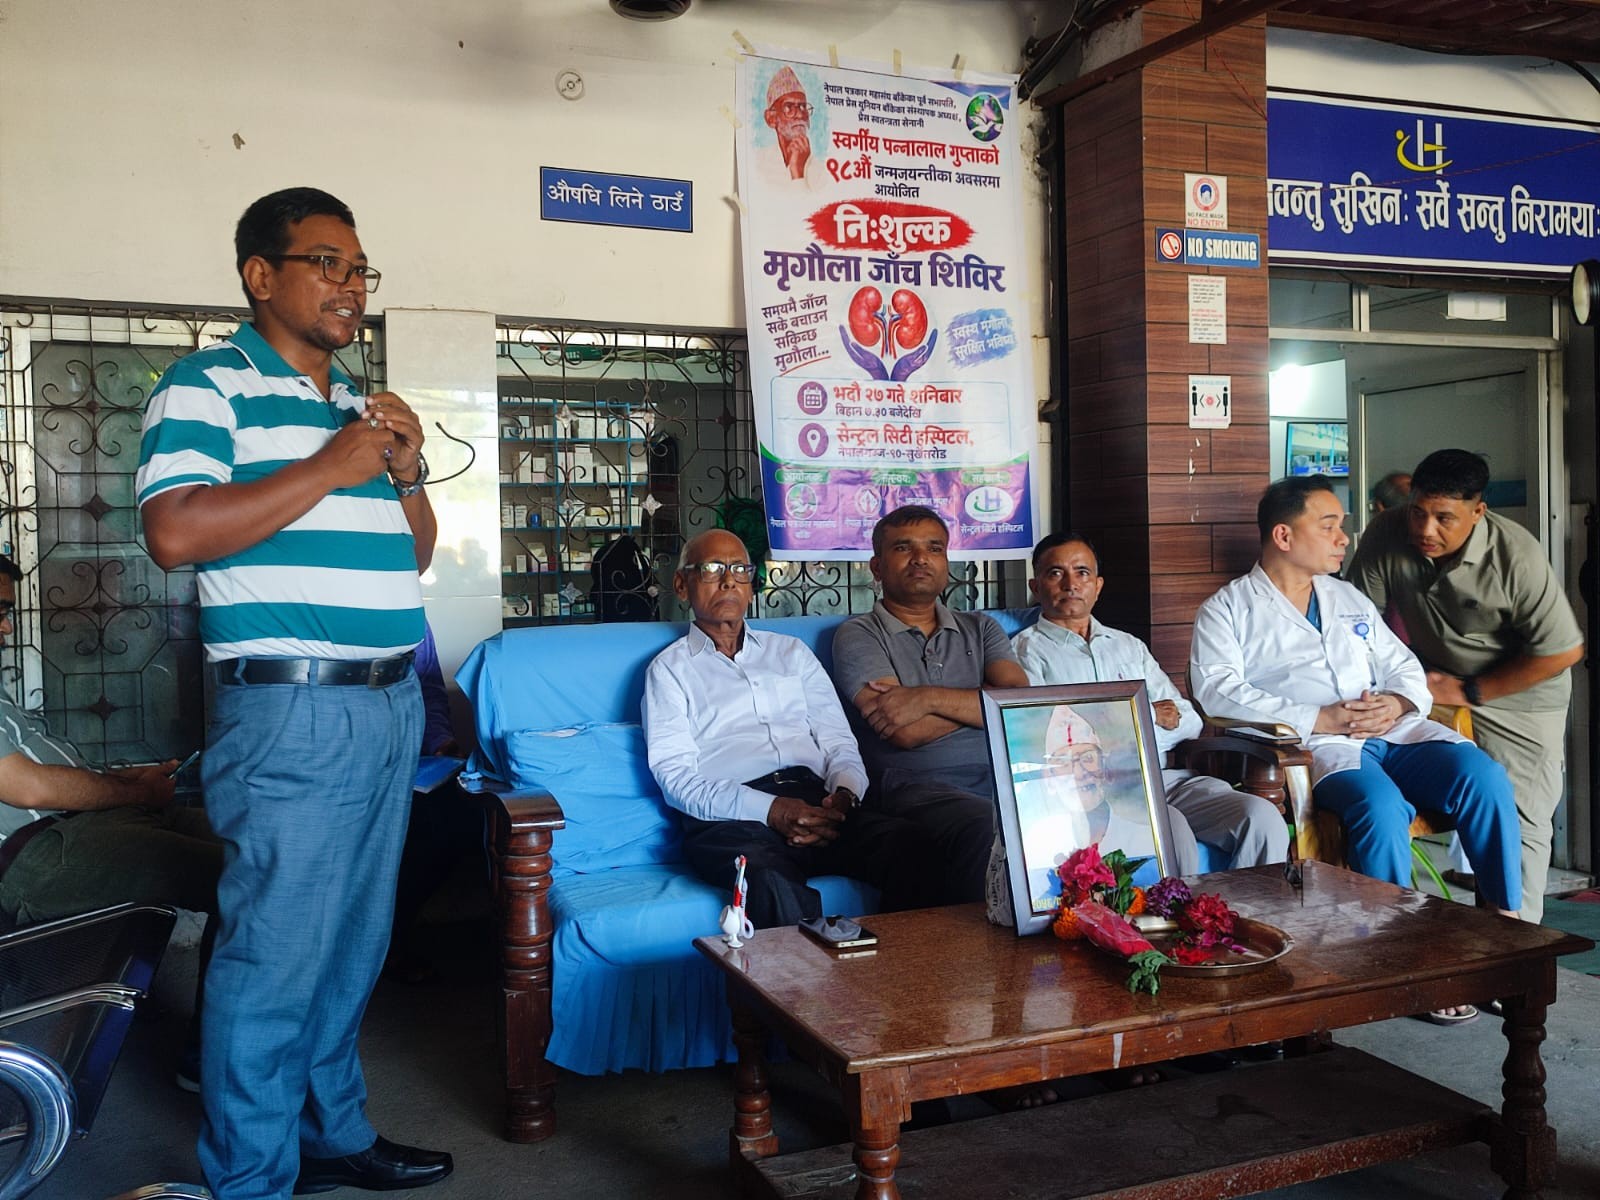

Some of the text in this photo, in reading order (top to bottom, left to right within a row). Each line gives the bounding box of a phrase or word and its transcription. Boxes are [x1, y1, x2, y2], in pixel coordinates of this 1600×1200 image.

[883, 138, 945, 159] पन्नालाल
[949, 144, 1000, 167] गुप्ताको
[875, 164, 952, 183] जन्मजयन्तीका
[955, 171, 1001, 188] अवसरमा
[546, 179, 684, 213] औषधि लिने ठाउँ
[875, 182, 920, 198] आयोजित
[1187, 218, 1225, 227] NO ENTRY
[1416, 179, 1451, 231] सर्वे
[1456, 193, 1507, 243] सन्तु
[1187, 237, 1257, 261] NO SMOKING
[763, 242, 1006, 293] मृगौला जाँच शिविर
[761, 296, 797, 319] समयमै
[766, 316, 788, 334] सके
[833, 381, 962, 404] भदौ २७ गते शनिबार
[836, 402, 862, 417] बिहान
[889, 405, 921, 419] बजेदेखि
[836, 422, 879, 446] सेन्ट्रल
[884, 423, 912, 444] सिटी
